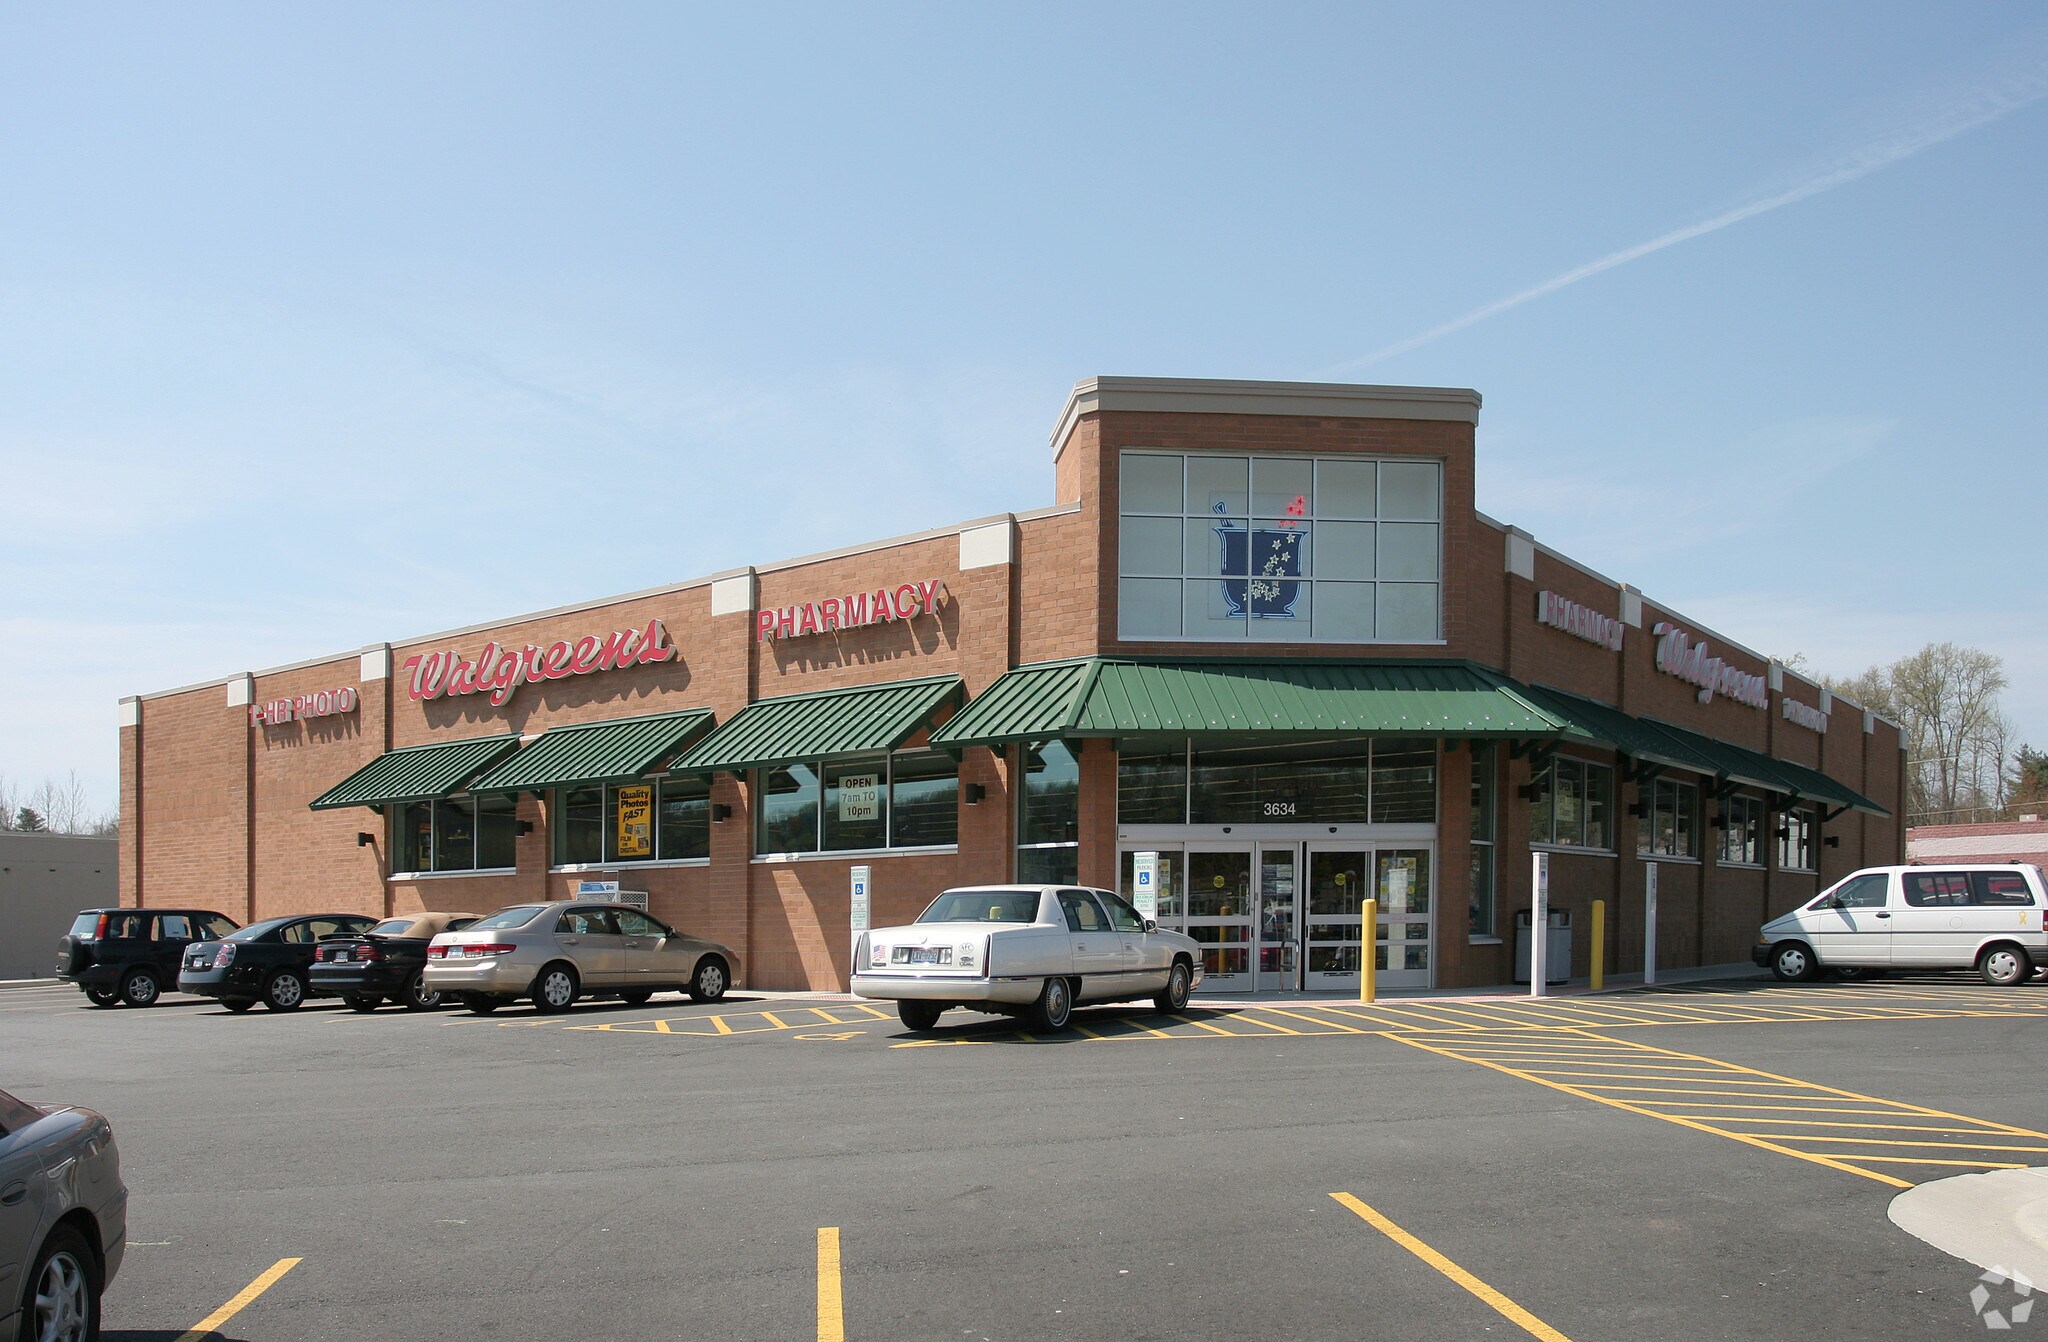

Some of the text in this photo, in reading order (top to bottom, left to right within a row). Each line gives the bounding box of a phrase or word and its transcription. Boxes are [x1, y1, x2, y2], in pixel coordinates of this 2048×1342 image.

[758, 579, 943, 642] PHARMACY
[1538, 590, 1625, 651] PHARMACY
[403, 618, 677, 707] Walgreens
[293, 687, 357, 721] PHOTO
[845, 778, 872, 789] OPEN
[620, 790, 649, 799] Quality
[841, 791, 876, 803] 7am TO
[620, 800, 649, 808] Photos
[1263, 803, 1296, 816] 3634
[622, 808, 645, 823] FAST
[847, 806, 871, 818] 10pm
